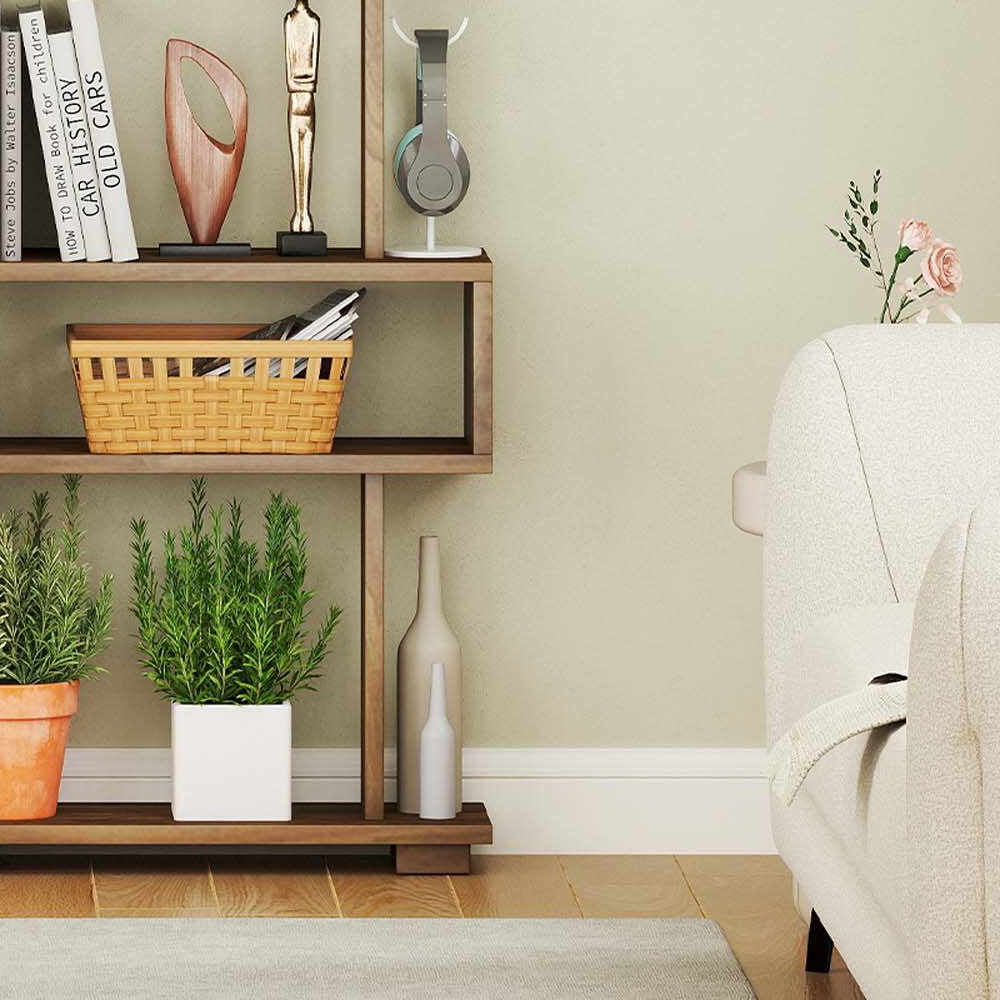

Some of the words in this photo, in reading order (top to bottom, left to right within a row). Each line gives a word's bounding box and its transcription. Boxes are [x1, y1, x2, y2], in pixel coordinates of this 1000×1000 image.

[5, 34, 16, 95] Isaacson
[30, 18, 48, 84] children
[42, 93, 53, 116] for
[84, 70, 111, 129] CARS
[4, 104, 16, 151] Walter
[59, 79, 91, 167] HISTORY
[5, 158, 18, 174] by
[53, 165, 69, 199] DRAW
[97, 144, 121, 188] OLD
[5, 180, 16, 211] Jobs
[60, 205, 73, 222] TO
[78, 179, 100, 217] CAR
[5, 219, 16, 257] Steve
[64, 229, 79, 256] HOW
